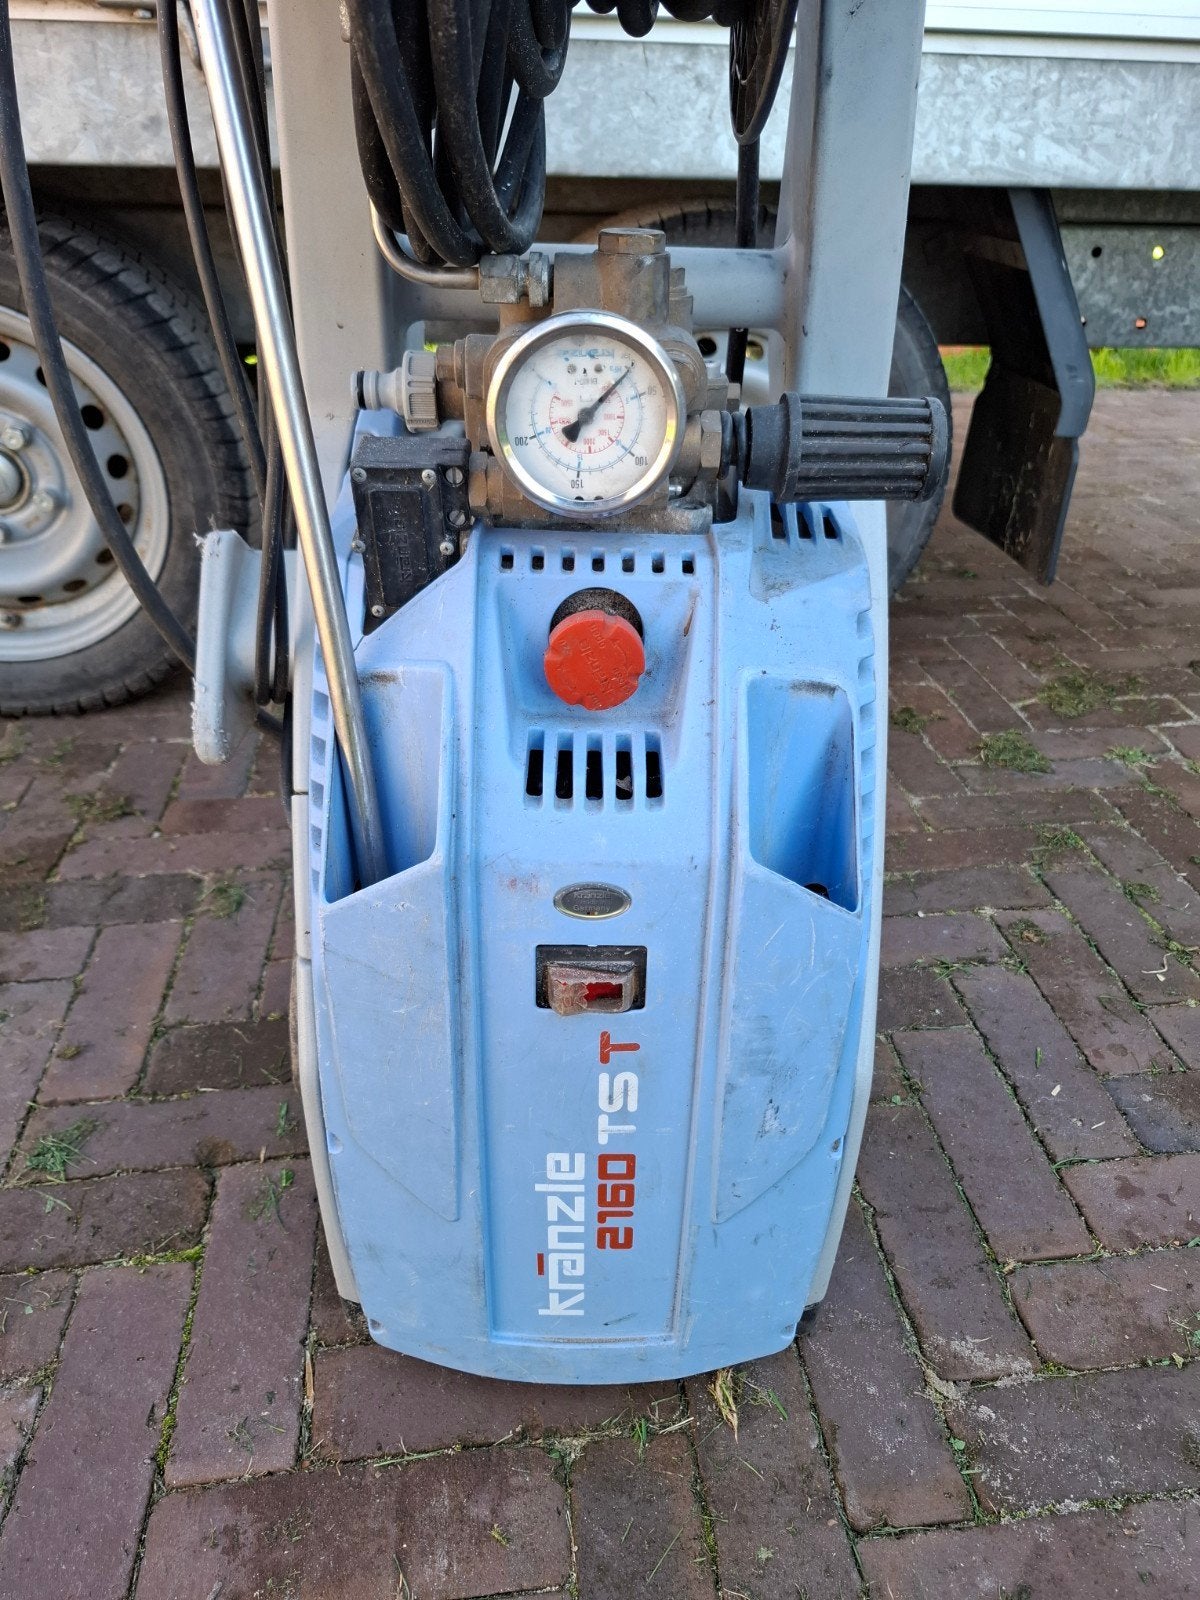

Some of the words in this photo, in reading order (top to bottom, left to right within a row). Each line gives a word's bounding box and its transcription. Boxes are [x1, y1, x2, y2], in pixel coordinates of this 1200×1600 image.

[647, 386, 657, 395] 50
[514, 436, 529, 446] 200
[634, 456, 649, 466] 100
[570, 479, 585, 489] 150
[596, 1153, 637, 1250] 2160
